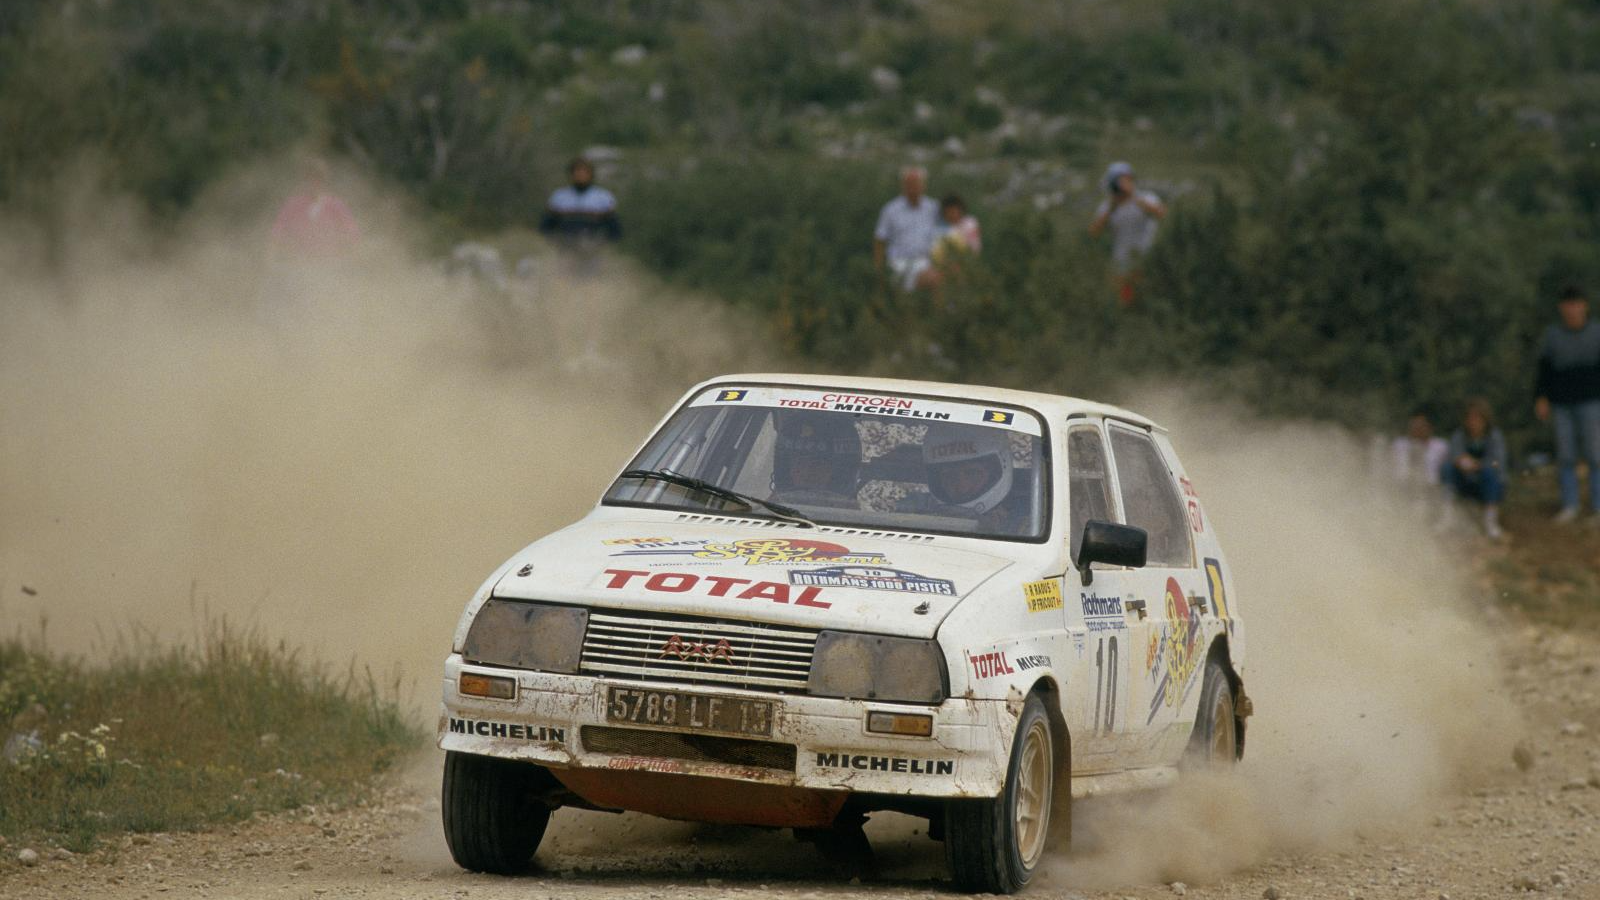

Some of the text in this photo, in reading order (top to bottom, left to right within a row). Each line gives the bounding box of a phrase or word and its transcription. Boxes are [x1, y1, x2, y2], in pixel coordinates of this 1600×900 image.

[778, 398, 951, 420] TOTAL MICHELIN
[822, 392, 913, 409] CITROËN
[603, 569, 833, 610] TOTAL
[793, 573, 869, 589] ROTHMANS
[906, 581, 952, 595] PISTES
[1080, 592, 1122, 615] Rothmans
[969, 651, 1015, 680] TOTAL
[1094, 635, 1118, 735] 10
[613, 688, 677, 724] 5789
[689, 696, 723, 728] LF
[449, 718, 565, 743] MICHELIN
[816, 752, 954, 775] MICHELIN
